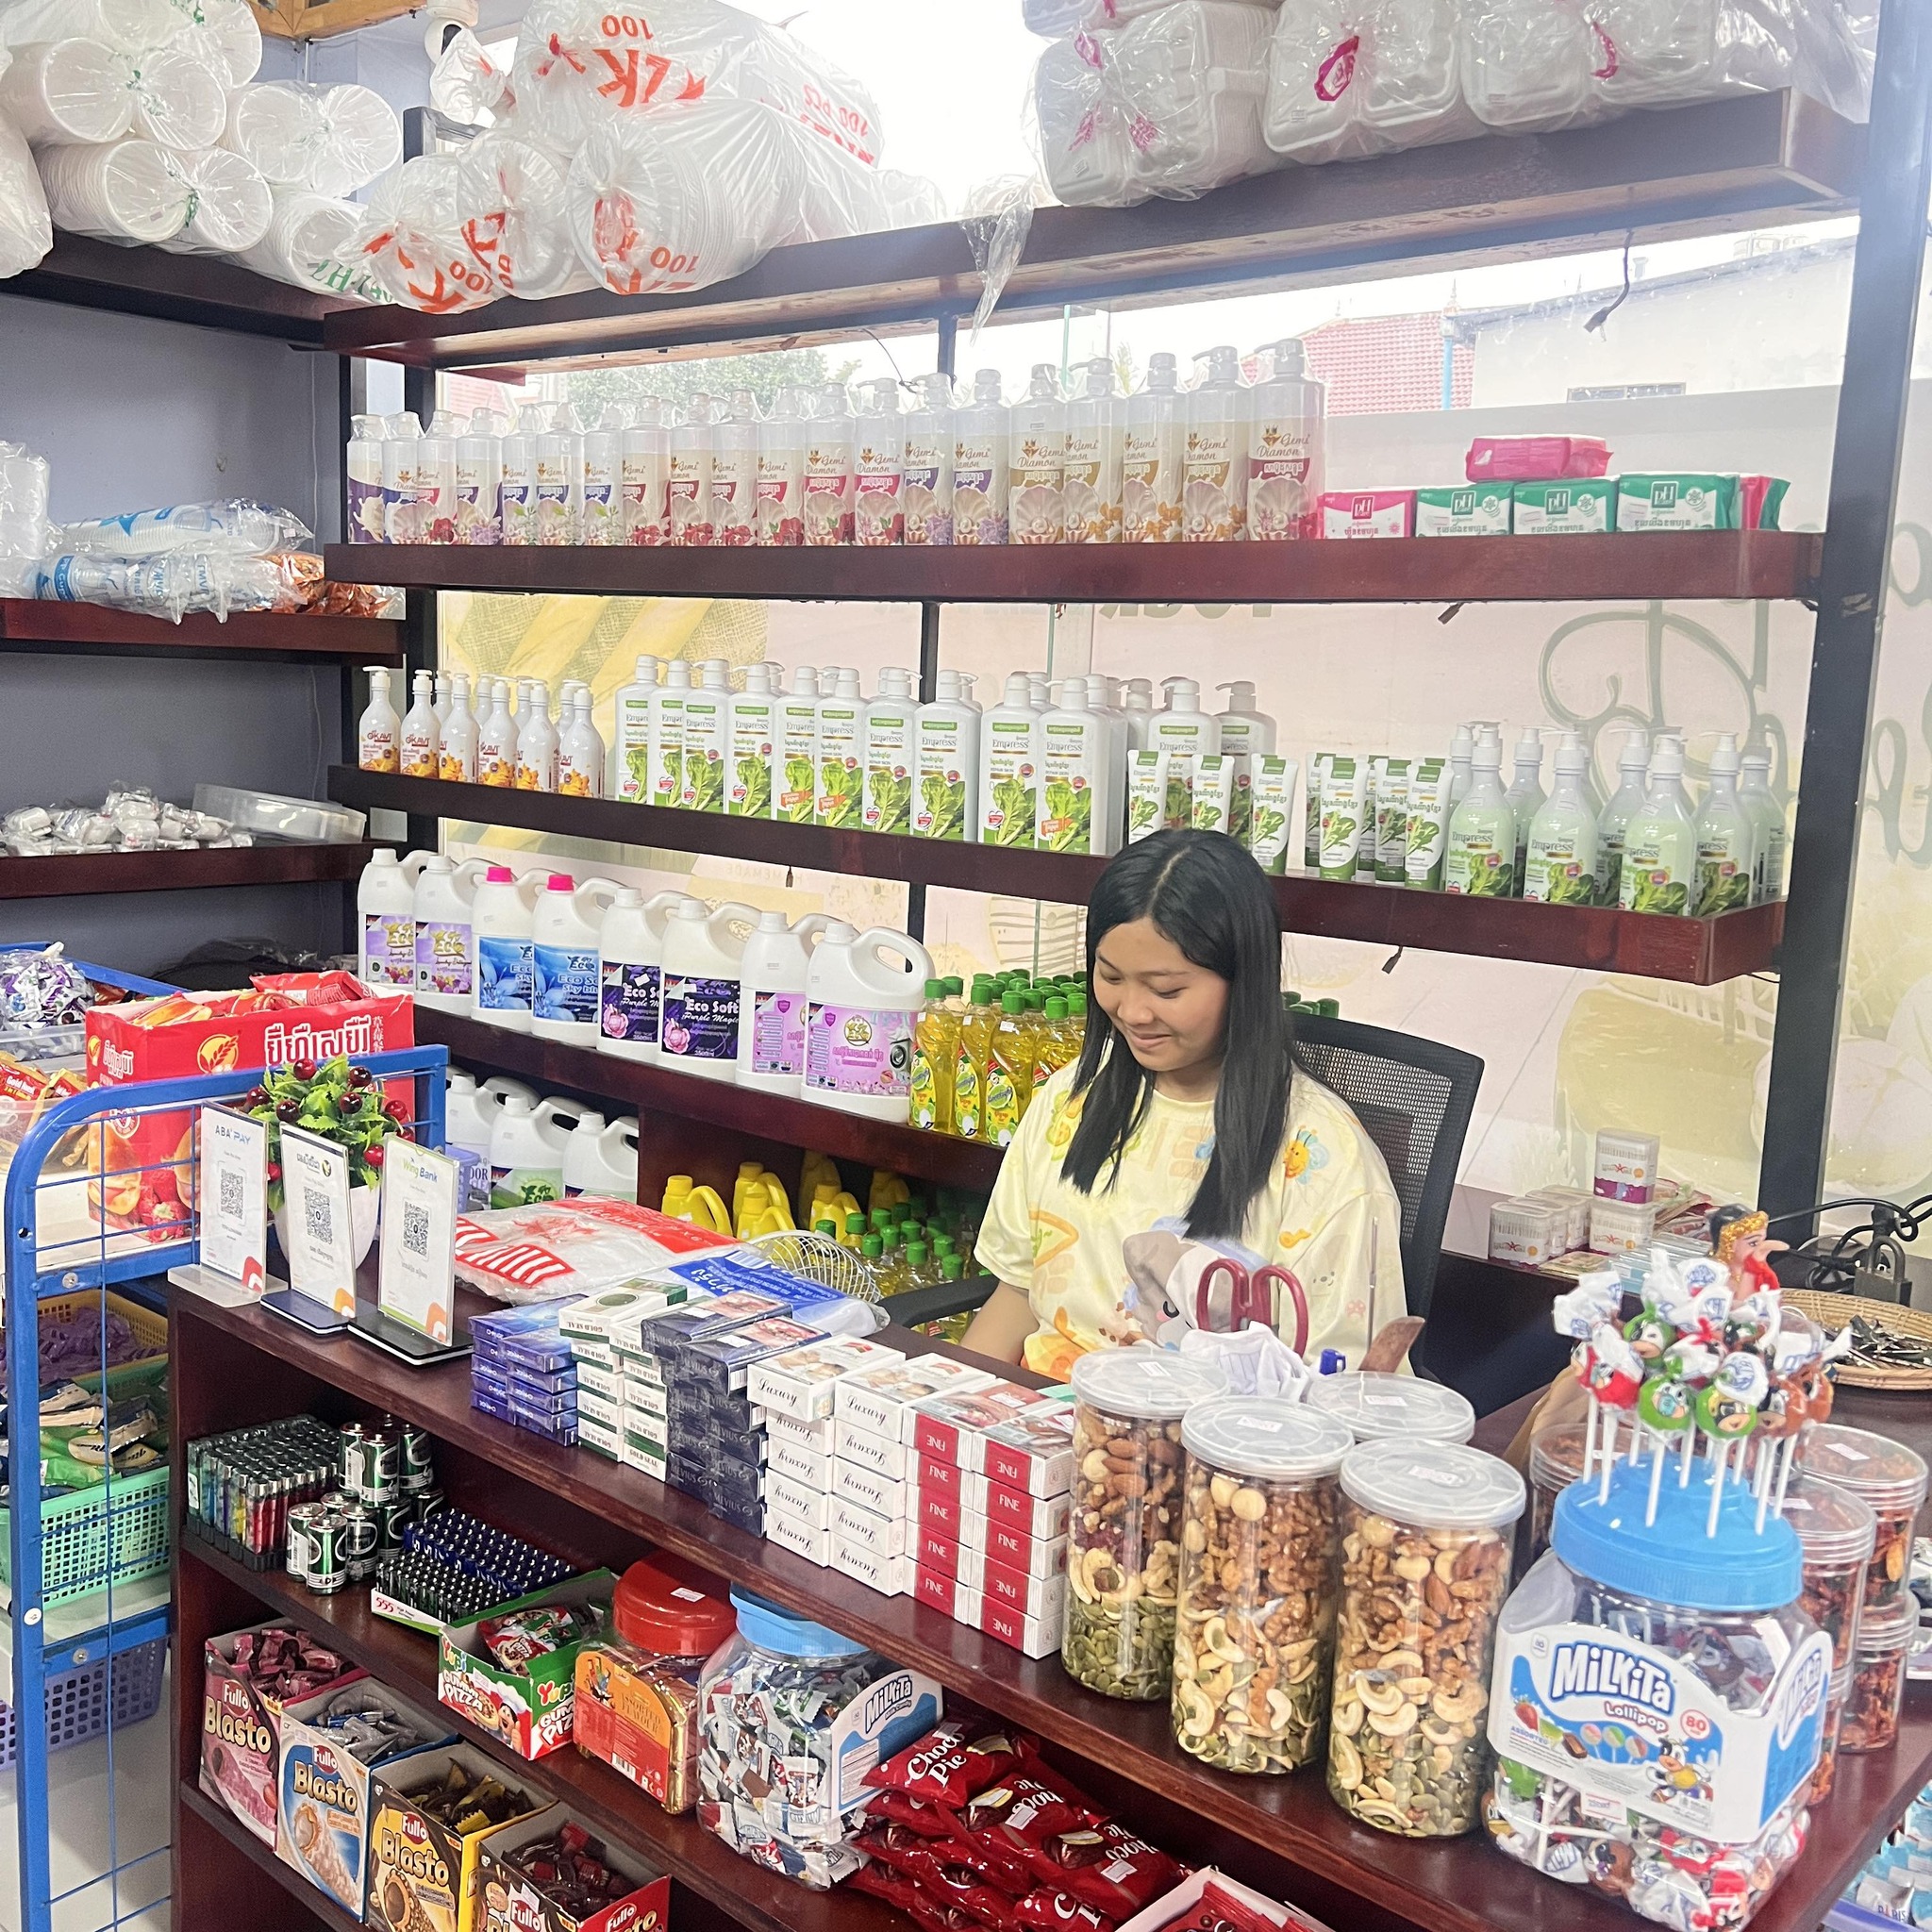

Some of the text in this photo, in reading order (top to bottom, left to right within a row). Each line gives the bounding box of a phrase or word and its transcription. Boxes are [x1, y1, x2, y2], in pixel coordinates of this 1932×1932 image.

[650, 246, 700, 273] 100
[558, 974, 598, 986] Eco So
[624, 983, 646, 998] Eco
[686, 998, 739, 1014] Eco Soft
[215, 1124, 251, 1144] ABA PAY
[402, 1158, 438, 1182] Wing Bank
[758, 1375, 798, 1407] Luxury
[847, 1394, 887, 1425] Luxury
[845, 1434, 887, 1466] Luxury
[926, 1435, 946, 1452] FINE
[778, 1449, 814, 1479] Luxury
[928, 1464, 949, 1482] FINE
[997, 1460, 1017, 1479] FINE
[774, 1485, 809, 1516] Luxury
[843, 1473, 883, 1505] Luxury
[999, 1493, 1020, 1512] FINE
[929, 1502, 948, 1520] FINE
[776, 1521, 811, 1553] Luxury
[838, 1511, 875, 1543] Luxury
[927, 1540, 946, 1557] FINE
[997, 1533, 1018, 1551] FINE
[840, 1548, 879, 1580] Luxury
[924, 1578, 943, 1595] FINE
[996, 1579, 1016, 1597] FINE
[375, 1597, 395, 1613] 555
[993, 1618, 1012, 1636] FINE
[442, 1637, 468, 1673] Yupi
[223, 1683, 250, 1710] Fullo
[445, 1683, 483, 1711] PIZZA
[205, 1696, 273, 1754] Blasto
[541, 1703, 574, 1729] GUM
[1604, 1701, 1668, 1733] Lollipop
[1686, 1715, 1707, 1730] 80
[542, 1715, 574, 1745] PIZ
[1510, 1725, 1549, 1745] ASSORTED
[313, 1745, 338, 1771] Fullo
[928, 1753, 967, 1788] Pie
[293, 1759, 358, 1813] Blasto
[401, 1812, 428, 1840] Fullo
[381, 1827, 450, 1888] Blasto
[510, 1899, 541, 1932] Fullo
